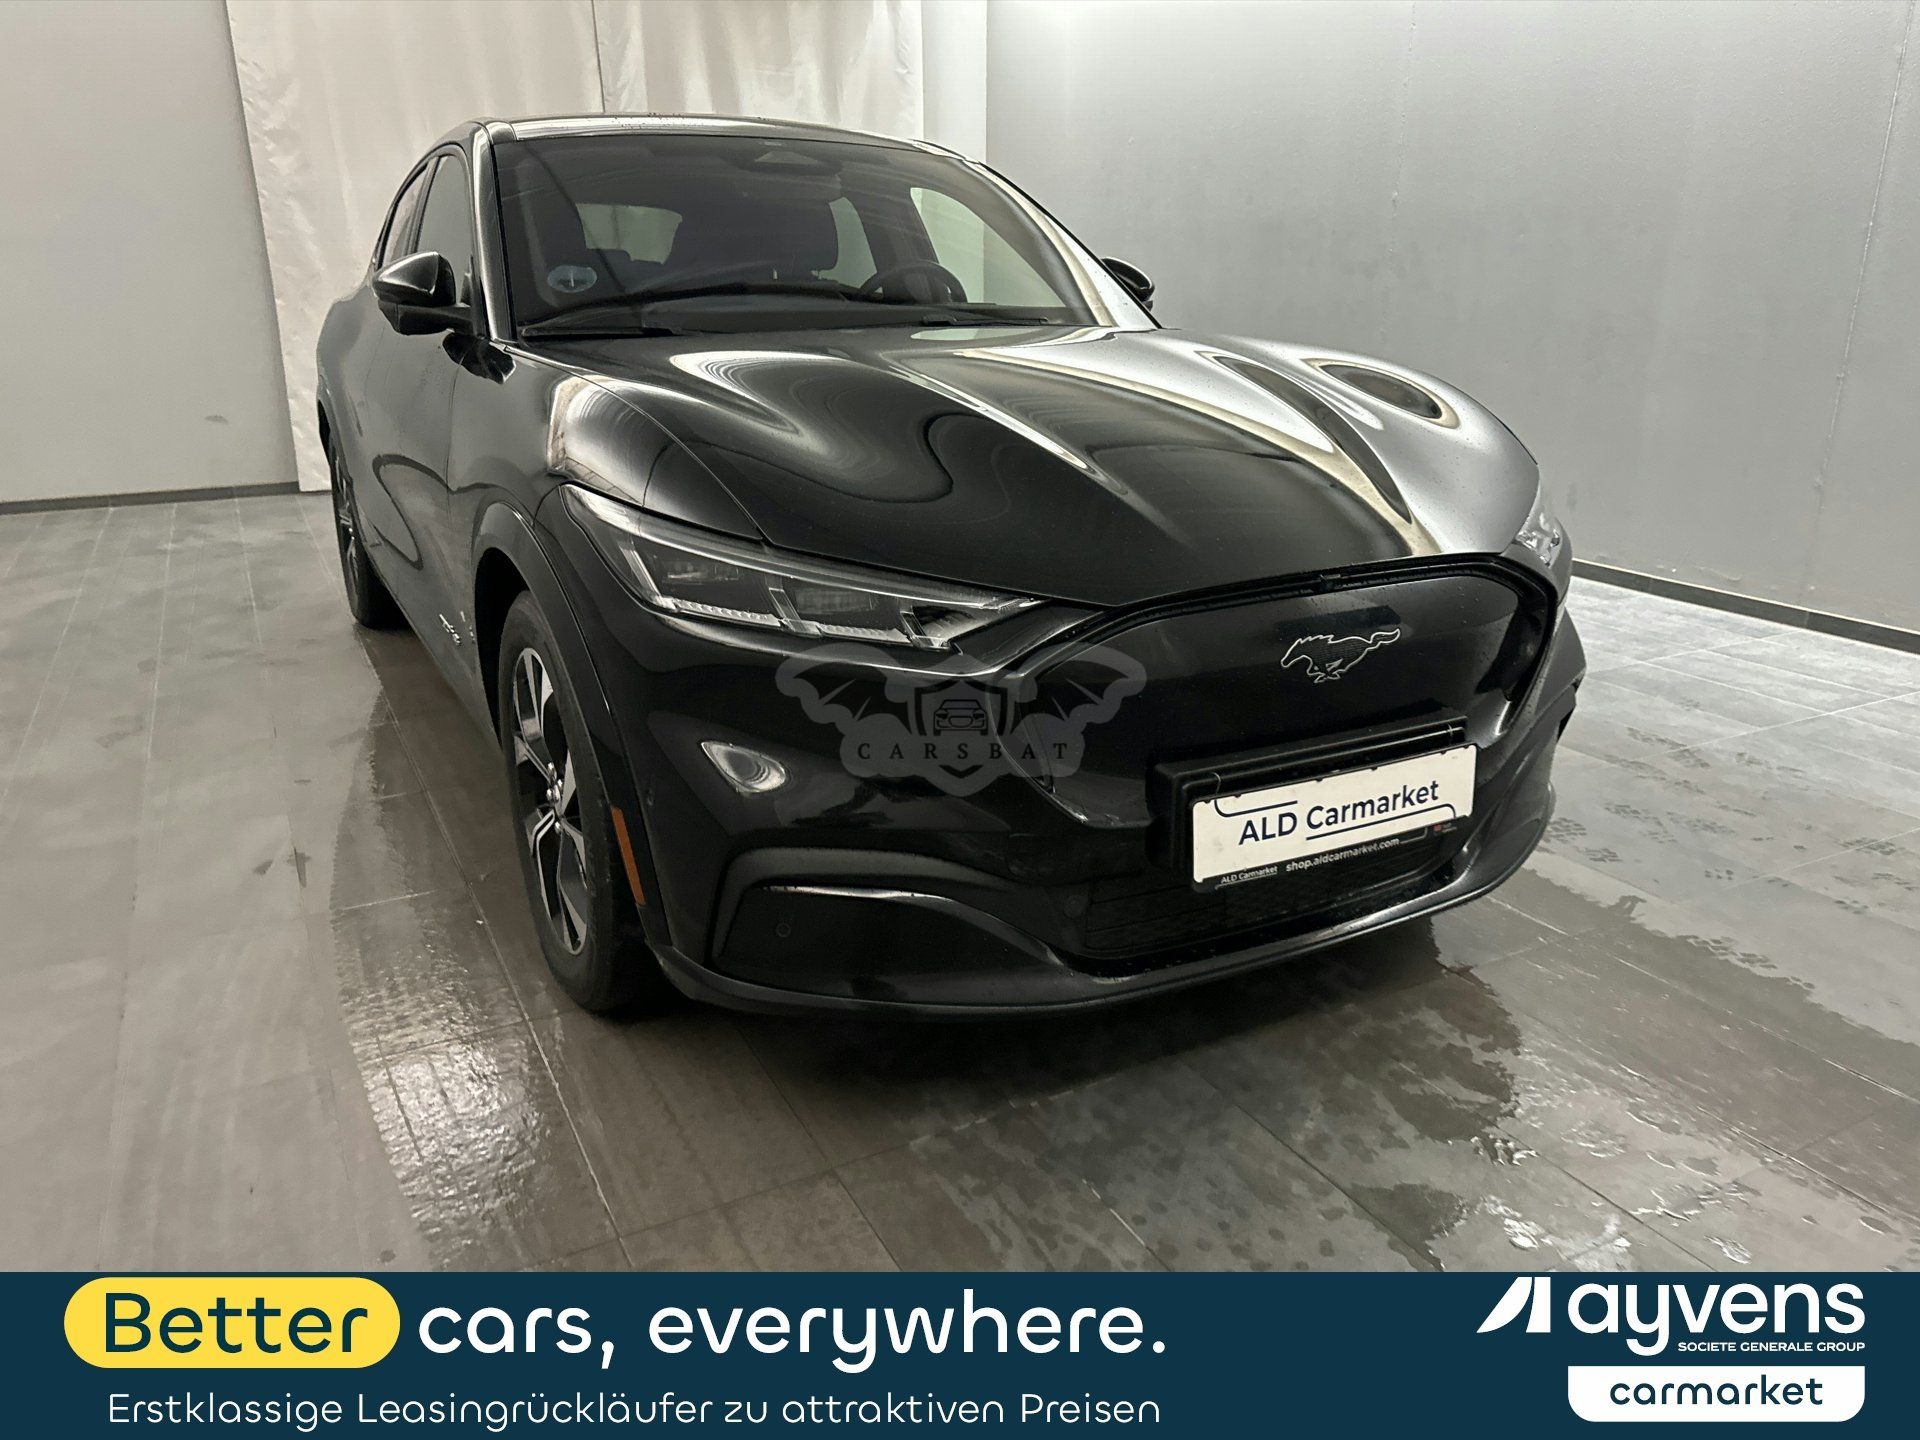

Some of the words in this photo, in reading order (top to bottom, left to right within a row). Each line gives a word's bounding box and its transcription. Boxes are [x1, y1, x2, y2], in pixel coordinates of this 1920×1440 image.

[1238, 812, 1297, 846] ALD
[1306, 780, 1439, 830] Carmarket
[1286, 837, 1400, 872] shop.aldcarmarket.com
[1221, 873, 1238, 884] ALD
[1239, 865, 1278, 880] Carmarket
